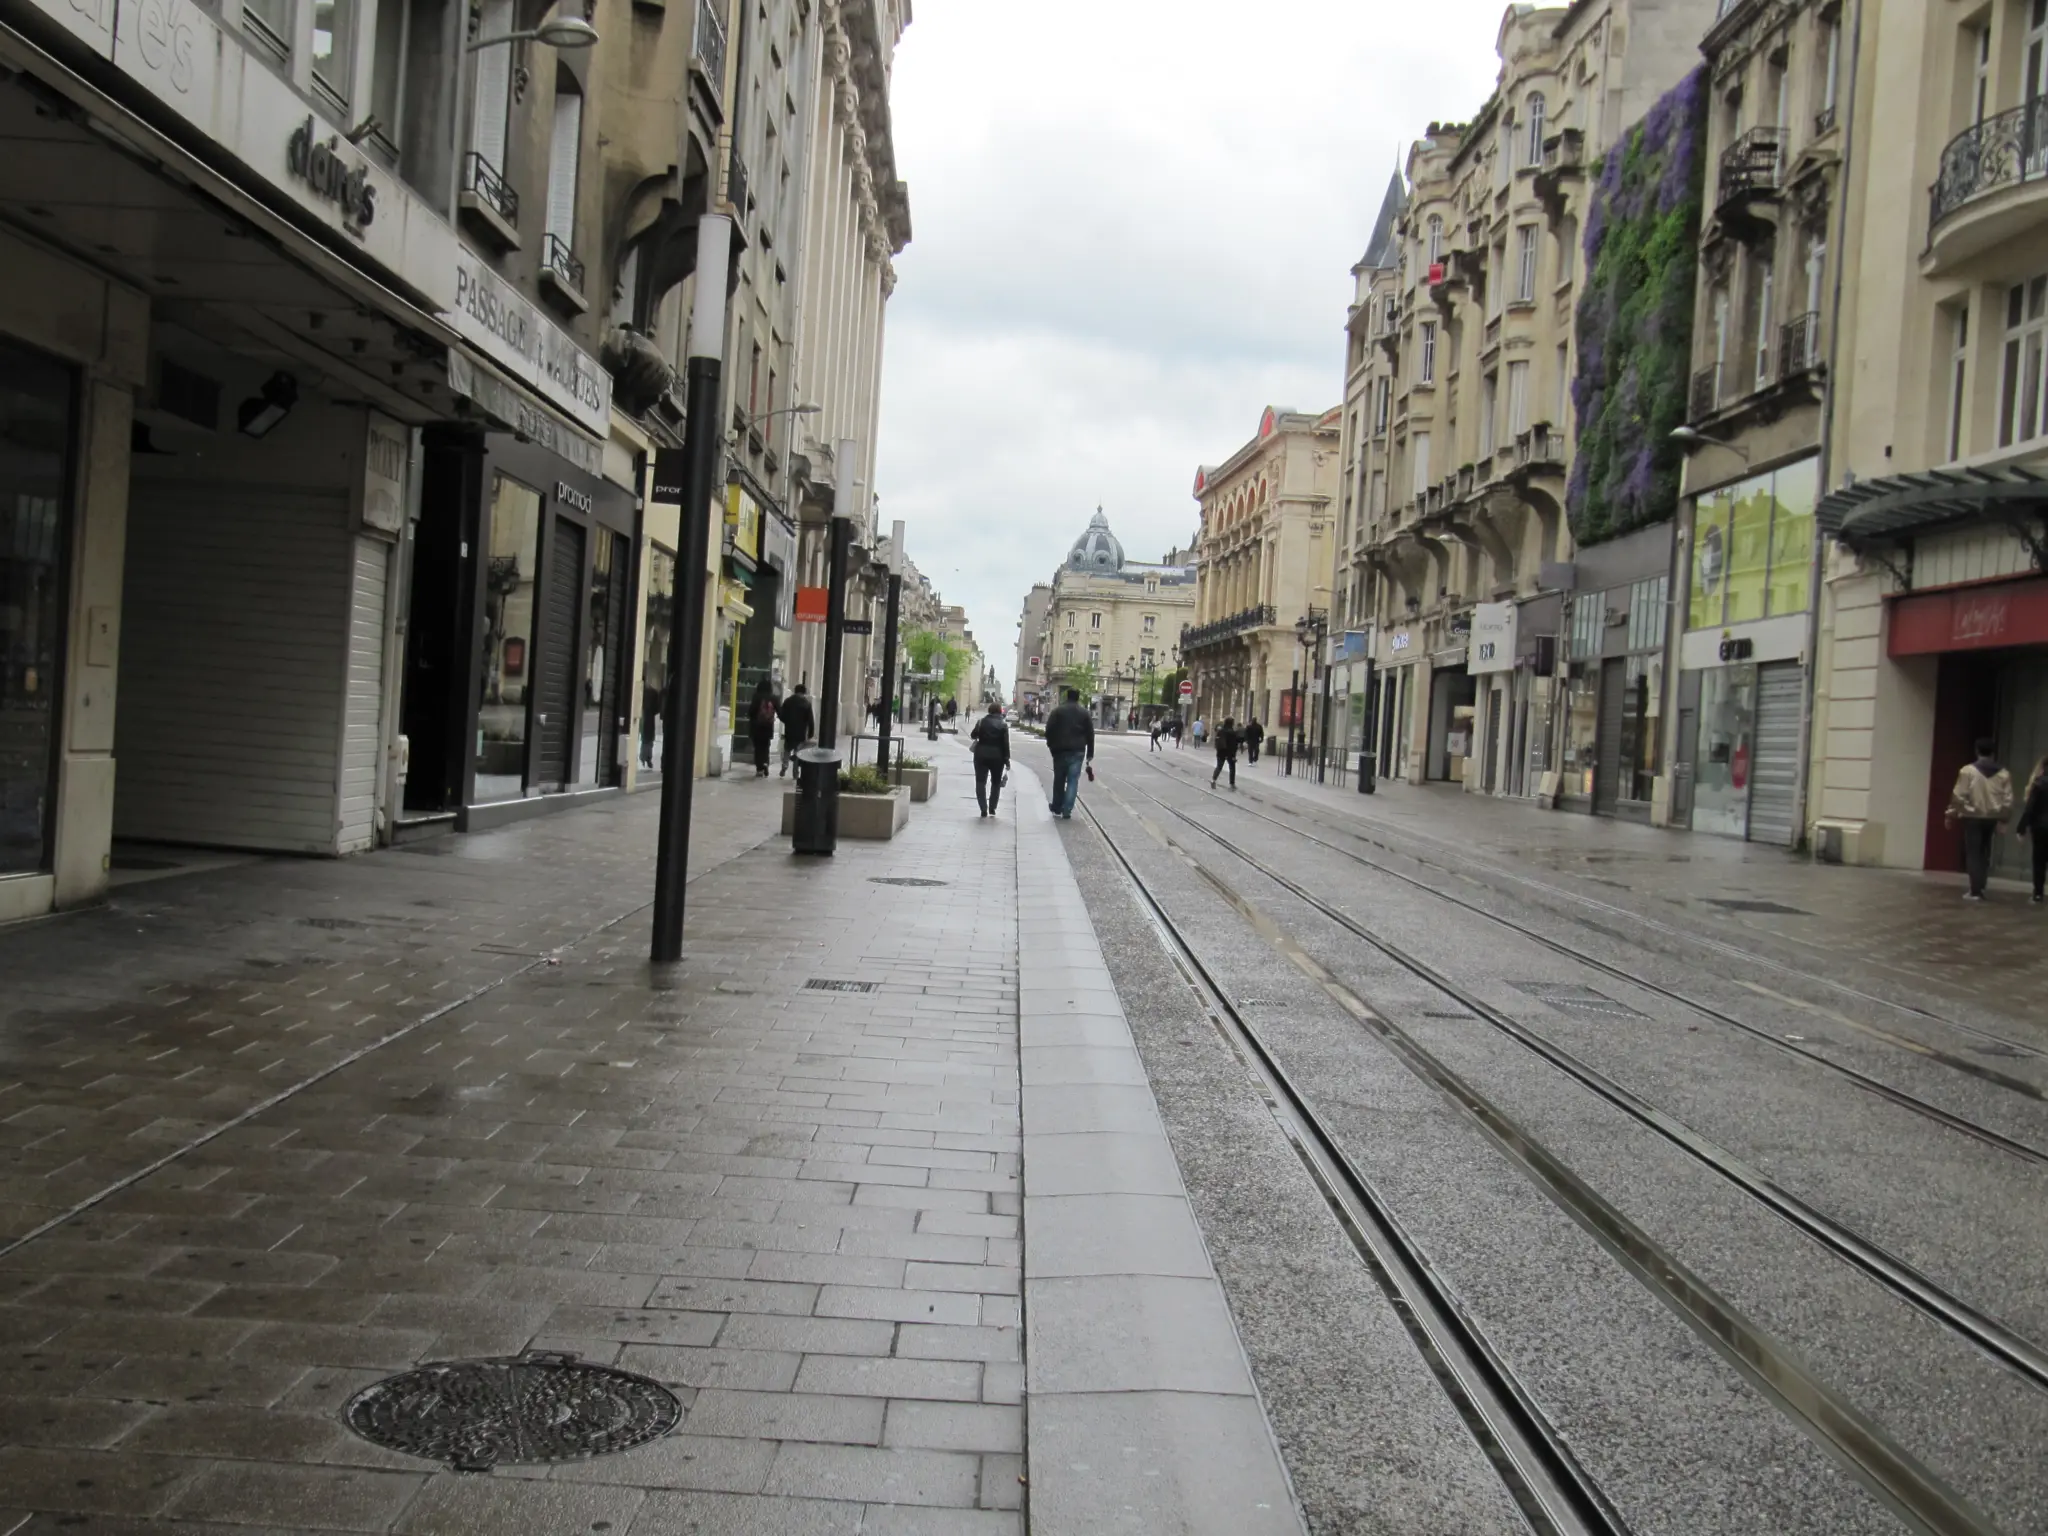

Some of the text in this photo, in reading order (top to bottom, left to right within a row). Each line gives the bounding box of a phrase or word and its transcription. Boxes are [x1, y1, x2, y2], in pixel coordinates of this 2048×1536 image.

[454, 265, 527, 352] PASSAGE
[557, 481, 592, 513] promod
[796, 613, 827, 621] orange
